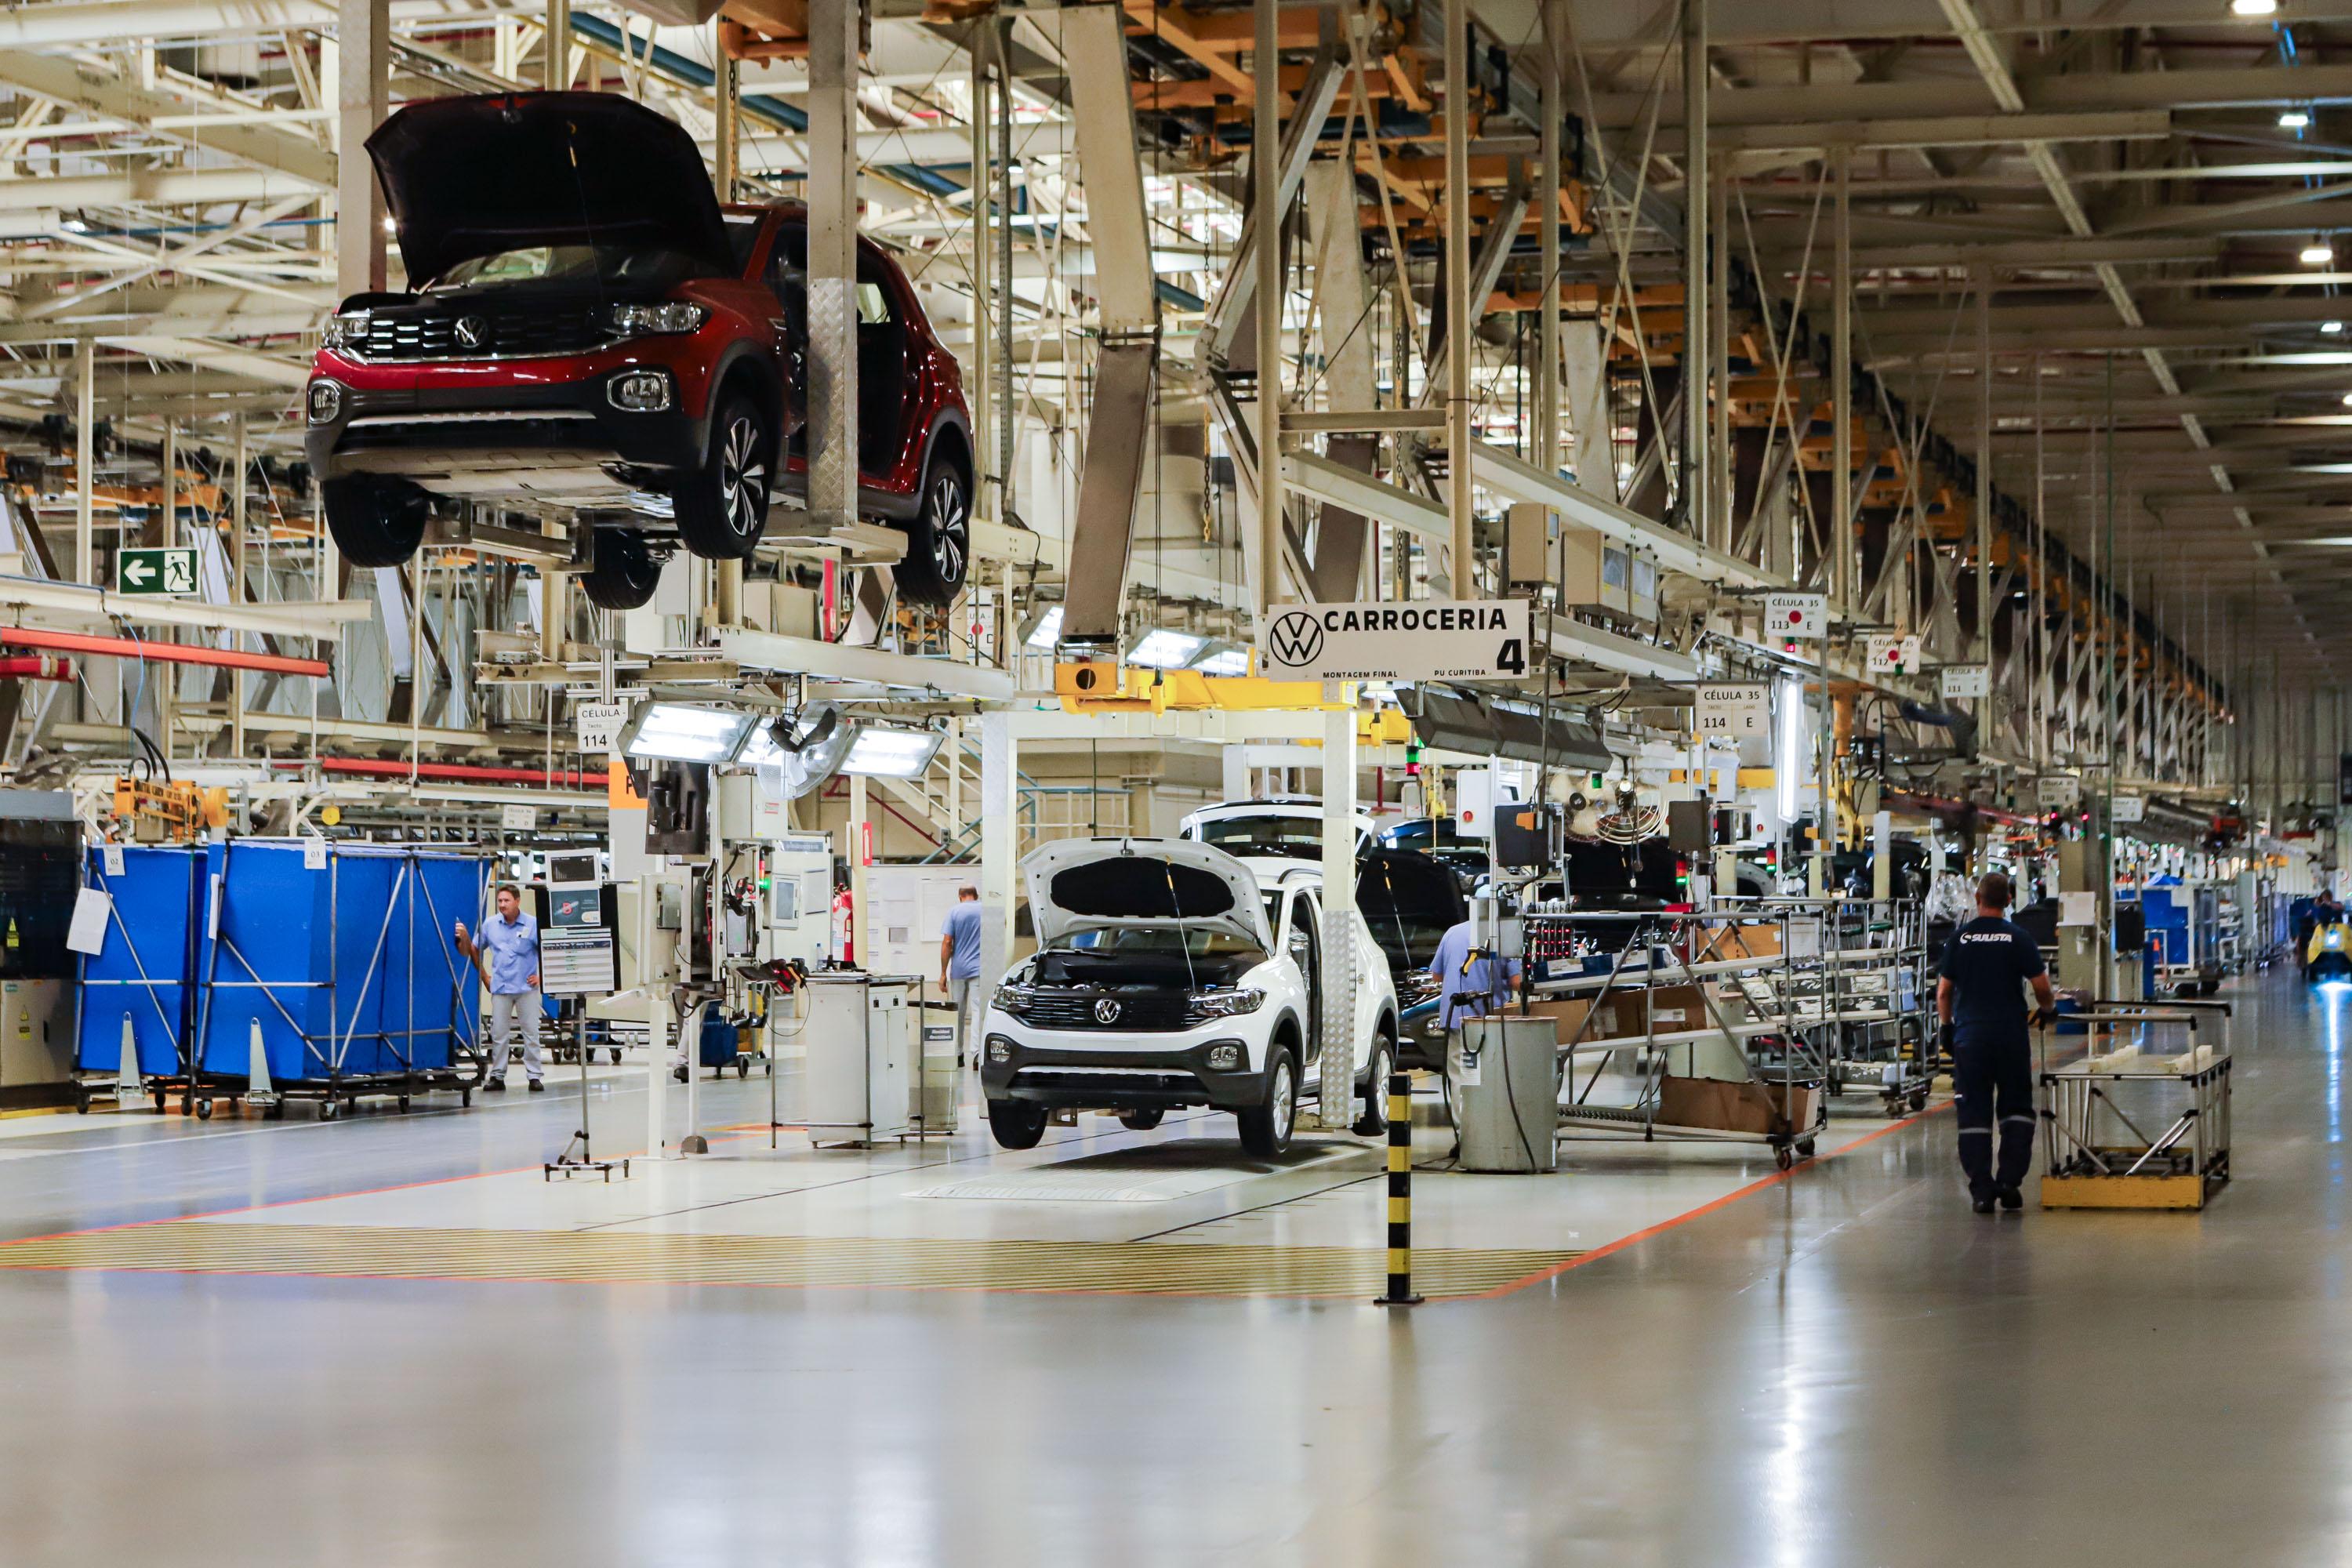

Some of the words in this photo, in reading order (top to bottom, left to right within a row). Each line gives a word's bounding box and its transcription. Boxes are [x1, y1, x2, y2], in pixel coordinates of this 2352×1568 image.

[1772, 597, 1803, 607] CÉLULA
[1323, 608, 1507, 632] CARROCERIA
[1772, 620, 1790, 630] 113
[1807, 622, 1813, 630] E
[1270, 612, 1323, 666] VW
[1497, 639, 1525, 675] 4
[1704, 689, 1742, 700] CÉLULA
[1748, 691, 1760, 699] 35
[582, 708, 620, 718] CÉLULA
[1704, 717, 1726, 728] 114
[1746, 717, 1753, 728] E
[583, 734, 608, 747] 114
[1971, 933, 2013, 942] SULISTA
[1095, 998, 1121, 1023] VW
